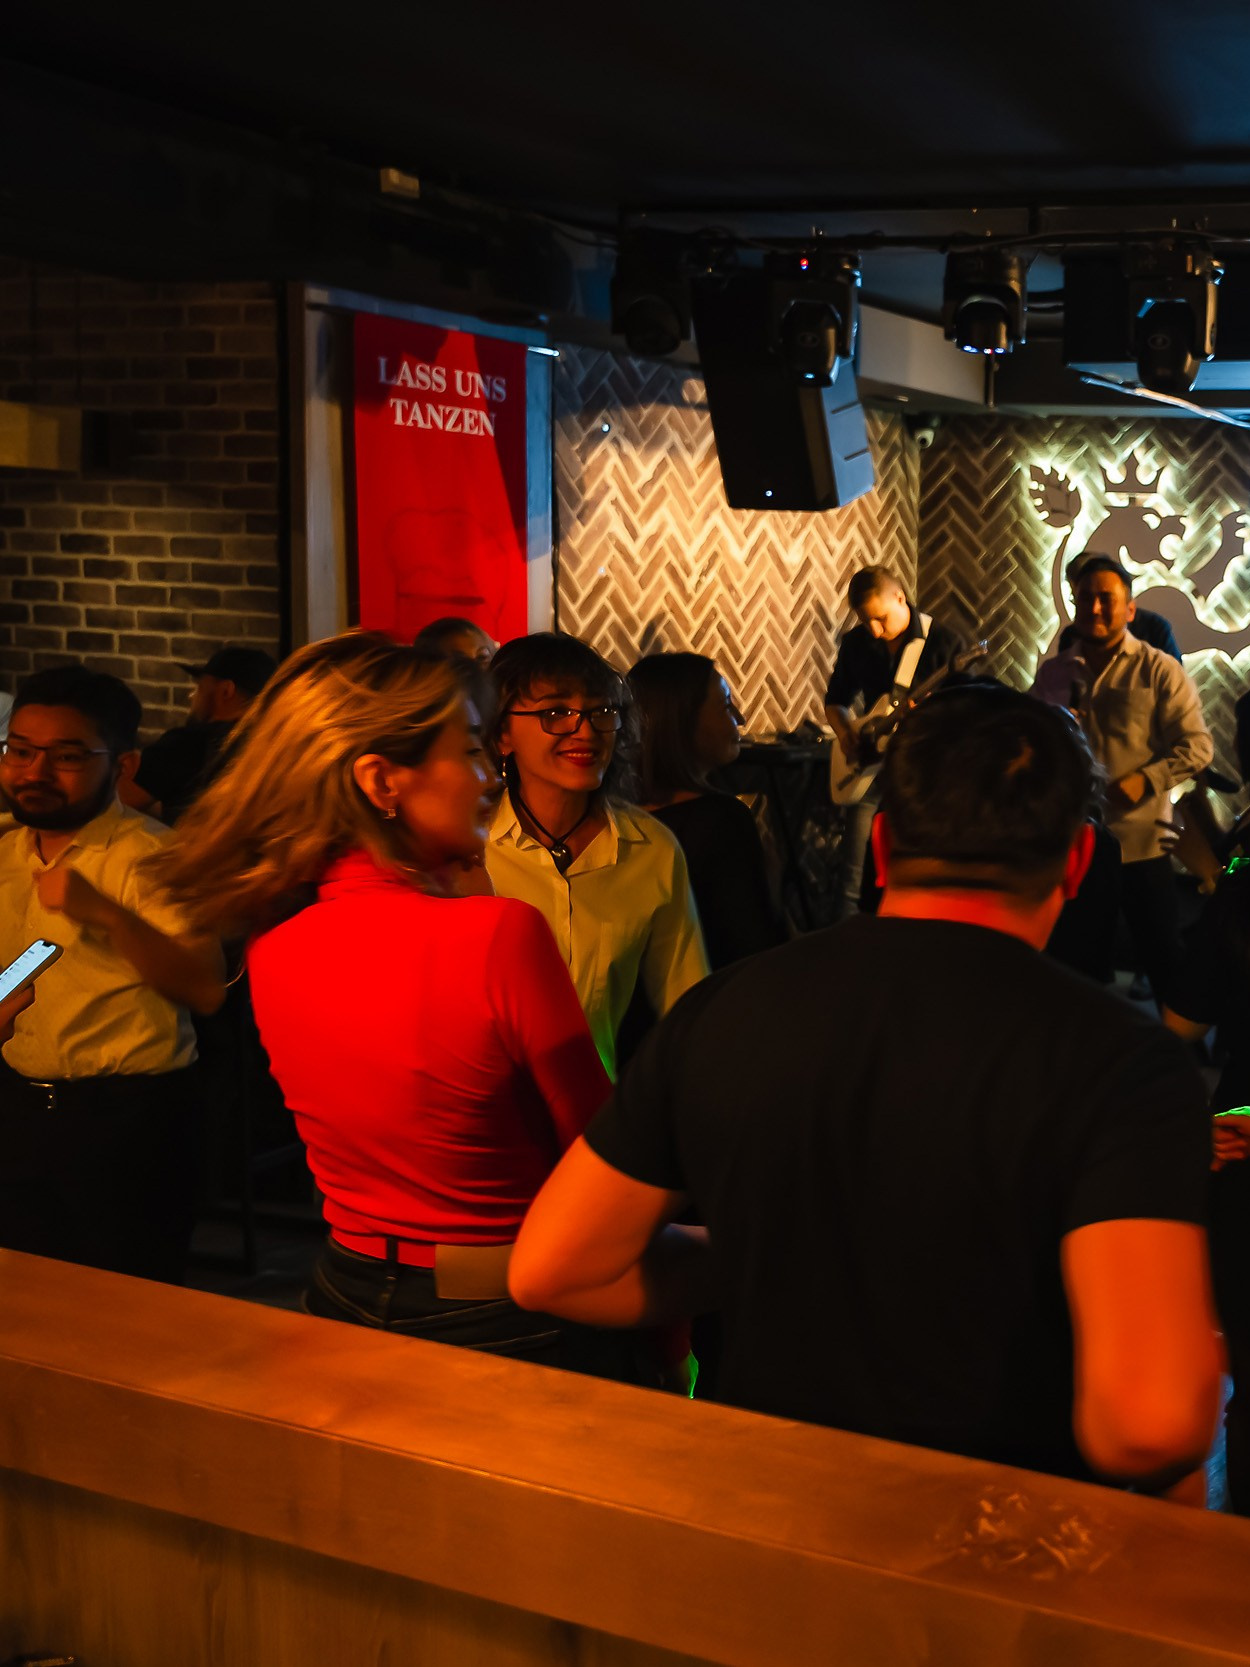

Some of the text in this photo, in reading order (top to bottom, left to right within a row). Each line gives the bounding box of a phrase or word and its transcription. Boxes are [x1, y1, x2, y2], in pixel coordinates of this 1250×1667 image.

[378, 356, 507, 403] LASS UNS
[390, 398, 496, 438] TANZEN
